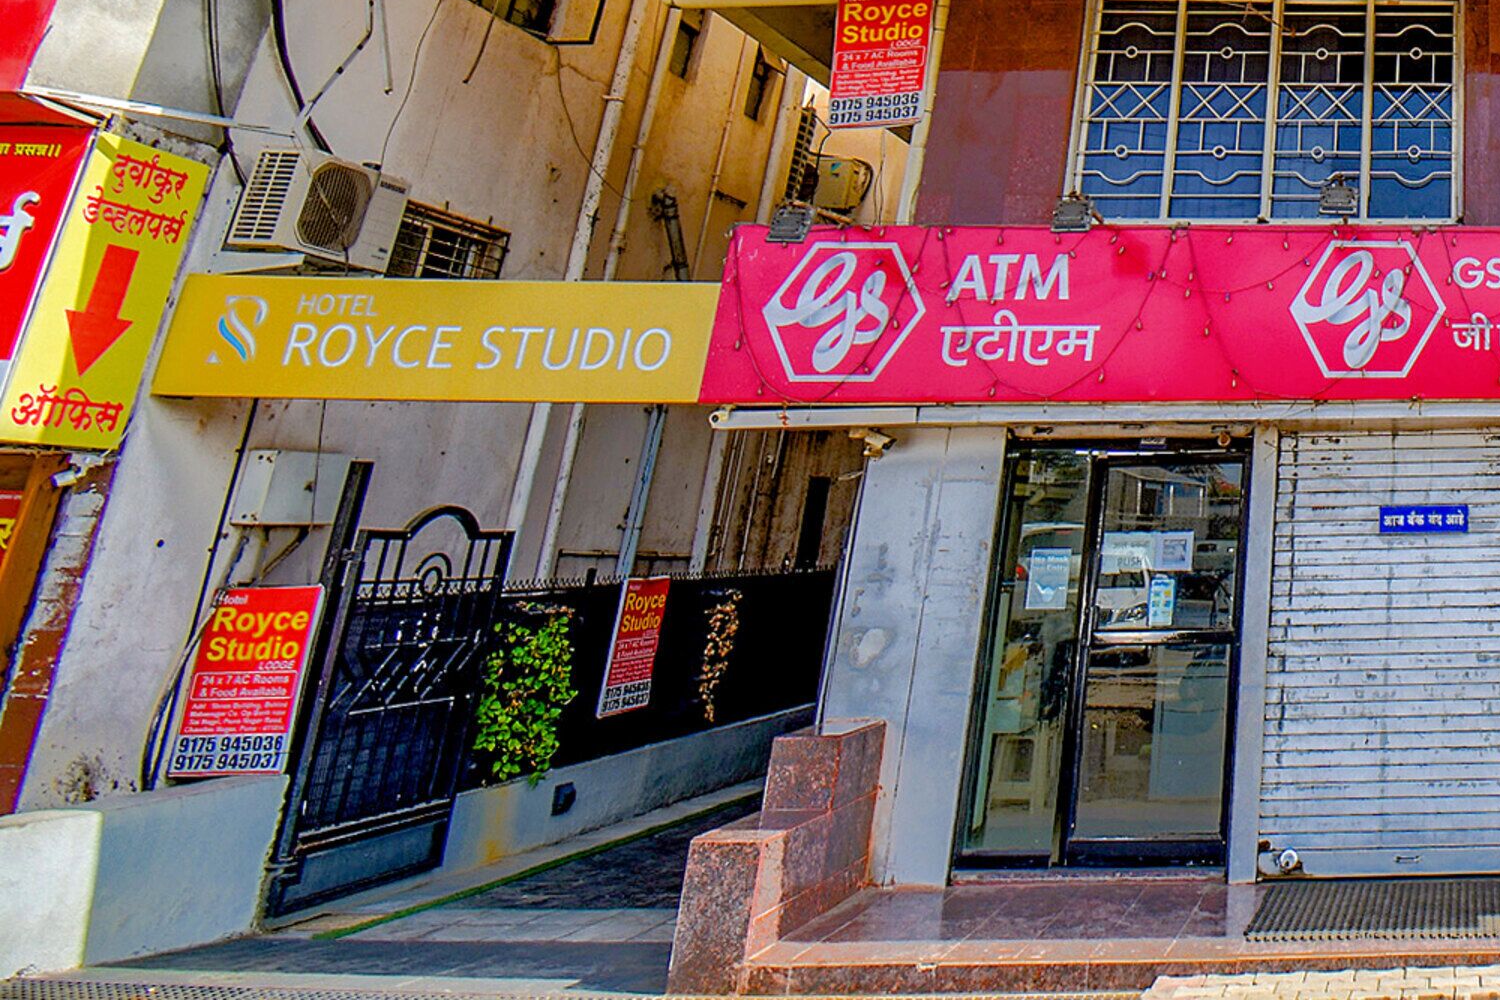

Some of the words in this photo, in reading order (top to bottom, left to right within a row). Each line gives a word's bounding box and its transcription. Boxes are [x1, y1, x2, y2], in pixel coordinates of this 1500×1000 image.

[843, 2, 928, 24] Royce
[842, 22, 924, 44] Studio
[831, 98, 862, 111] 9175
[866, 92, 919, 109] 945036
[830, 112, 861, 124] 9175
[865, 105, 917, 121] 945037
[948, 254, 1070, 301] ATM
[297, 294, 378, 317] HOTEL
[282, 323, 463, 369] ROYCE
[475, 327, 672, 372] STUDIO
[941, 309, 1101, 366] एटीएम
[11, 383, 124, 433] ऑफिस
[1384, 515, 1404, 526] आज
[1446, 509, 1464, 526] आहे
[625, 593, 666, 613] Royce
[213, 607, 310, 638] Royce
[621, 612, 661, 632] Studio
[206, 636, 299, 662] Studio
[233, 675, 251, 684] AC
[210, 688, 237, 697] Food
[178, 737, 217, 753] 9175
[221, 735, 284, 752] 945036
[175, 754, 216, 770] 9175
[216, 753, 281, 769] 945037
